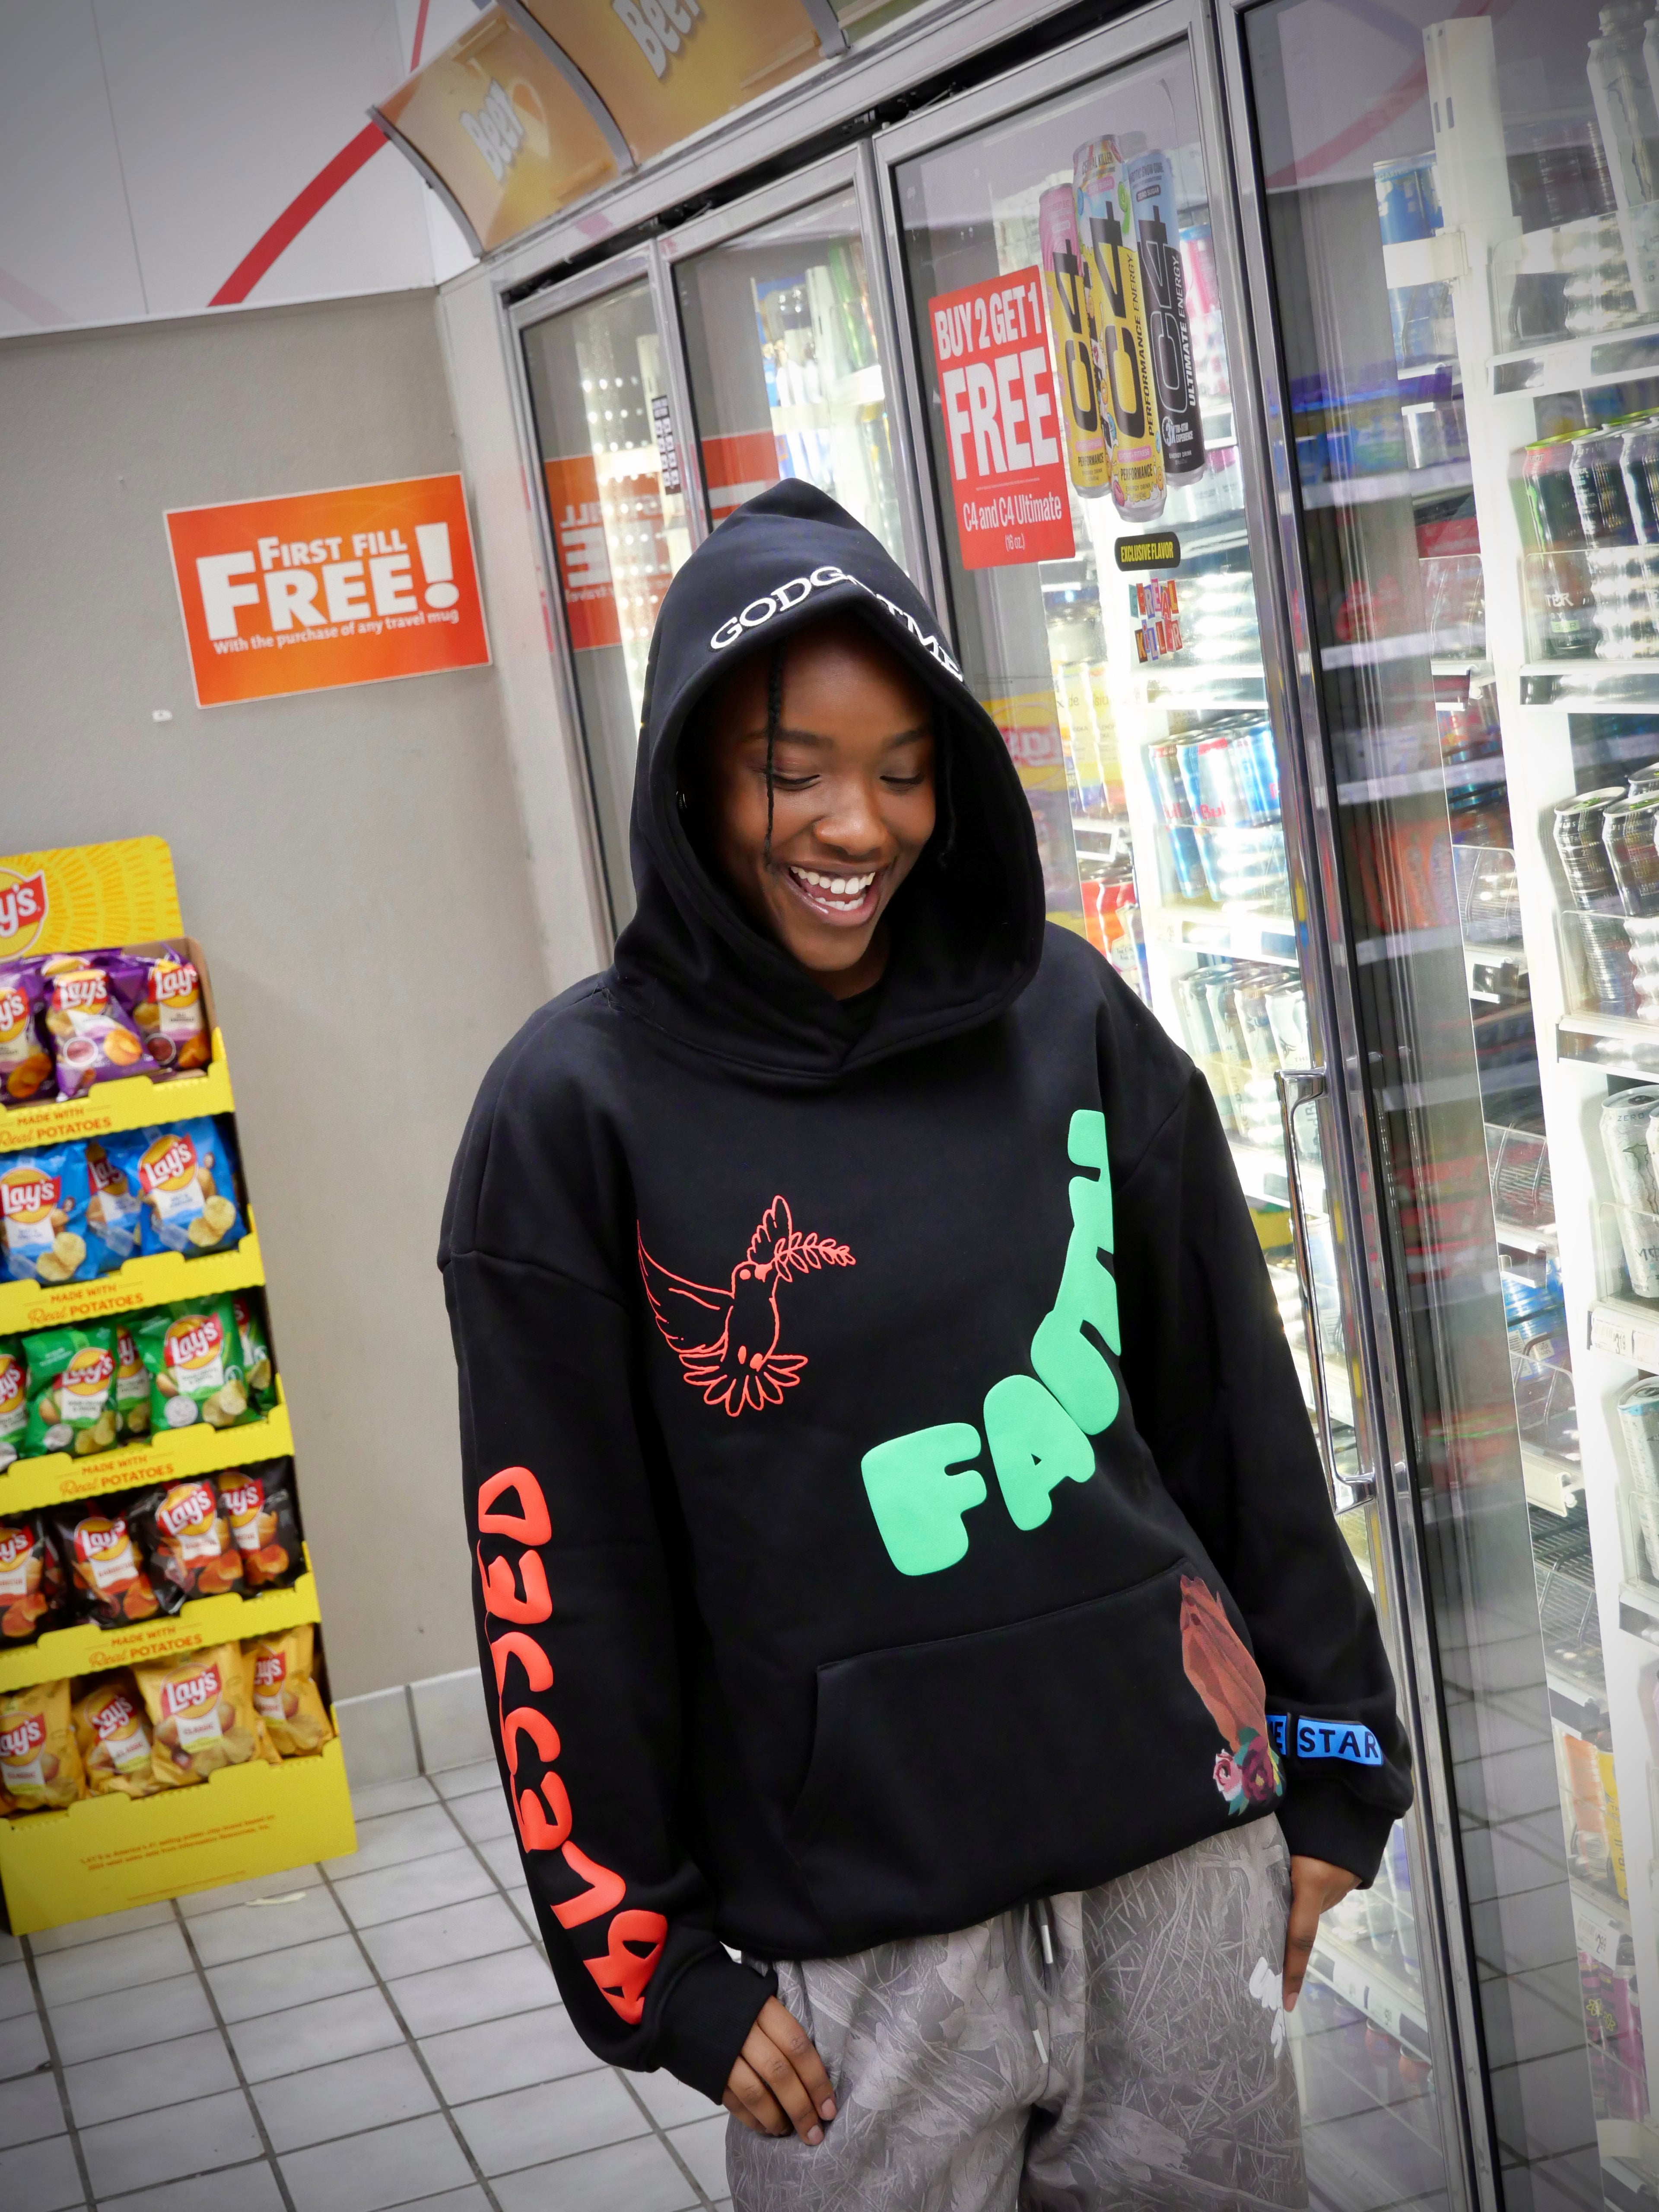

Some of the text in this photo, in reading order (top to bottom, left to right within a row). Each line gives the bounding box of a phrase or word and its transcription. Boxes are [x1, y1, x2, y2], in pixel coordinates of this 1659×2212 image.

[459, 78, 525, 184] Beer
[1137, 187, 1159, 200] ZERO SUGAR
[934, 282, 1042, 360] BUY 2 GET 1
[1089, 200, 1145, 439] C4
[1138, 205, 1187, 413] C4
[1052, 239, 1097, 432] C4
[1126, 253, 1155, 436] PERFORMANCE ENERGY
[1172, 255, 1196, 407] ULTIMATE ENERGY
[942, 346, 1059, 480] FREE
[1166, 423, 1176, 447] 3X
[1176, 431, 1193, 443] EXPERIENCE
[1078, 453, 1104, 466] PERFORMANCE
[1134, 448, 1150, 458] FITNESS
[1121, 464, 1152, 480] PERFORMANCE
[963, 491, 1062, 533] C4 and C4 Ultimate
[258, 529, 407, 570] FIRST FILL
[1005, 533, 1025, 551] (16 oz.)
[1120, 541, 1174, 563] EXCLUSIVE FLAVOR
[196, 522, 460, 641] FREE!
[213, 609, 460, 655] With the purchase of any travel mug
[17, 1107, 85, 1126] MADE WITH
[36, 1117, 112, 1139] POTATOES
[1618, 1113, 1644, 1122] ZERO
[144, 1143, 192, 1188] Lay's
[0, 1179, 54, 1215] Lay's
[50, 1284, 117, 1304] MADE WITH
[70, 1293, 144, 1316] POTATOES
[170, 1322, 218, 1364] Lay's
[81, 1455, 147, 1475] MADE WITH
[101, 1464, 174, 1487] POTATOES
[161, 1490, 211, 1535] Lay's
[111, 1627, 176, 1646] MADE WITH
[130, 1634, 203, 1660] POTATOES
[166, 1671, 218, 1714] Lay's
[183, 1723, 214, 1735] CLASSIC
[1299, 1727, 1378, 1758] STAR
